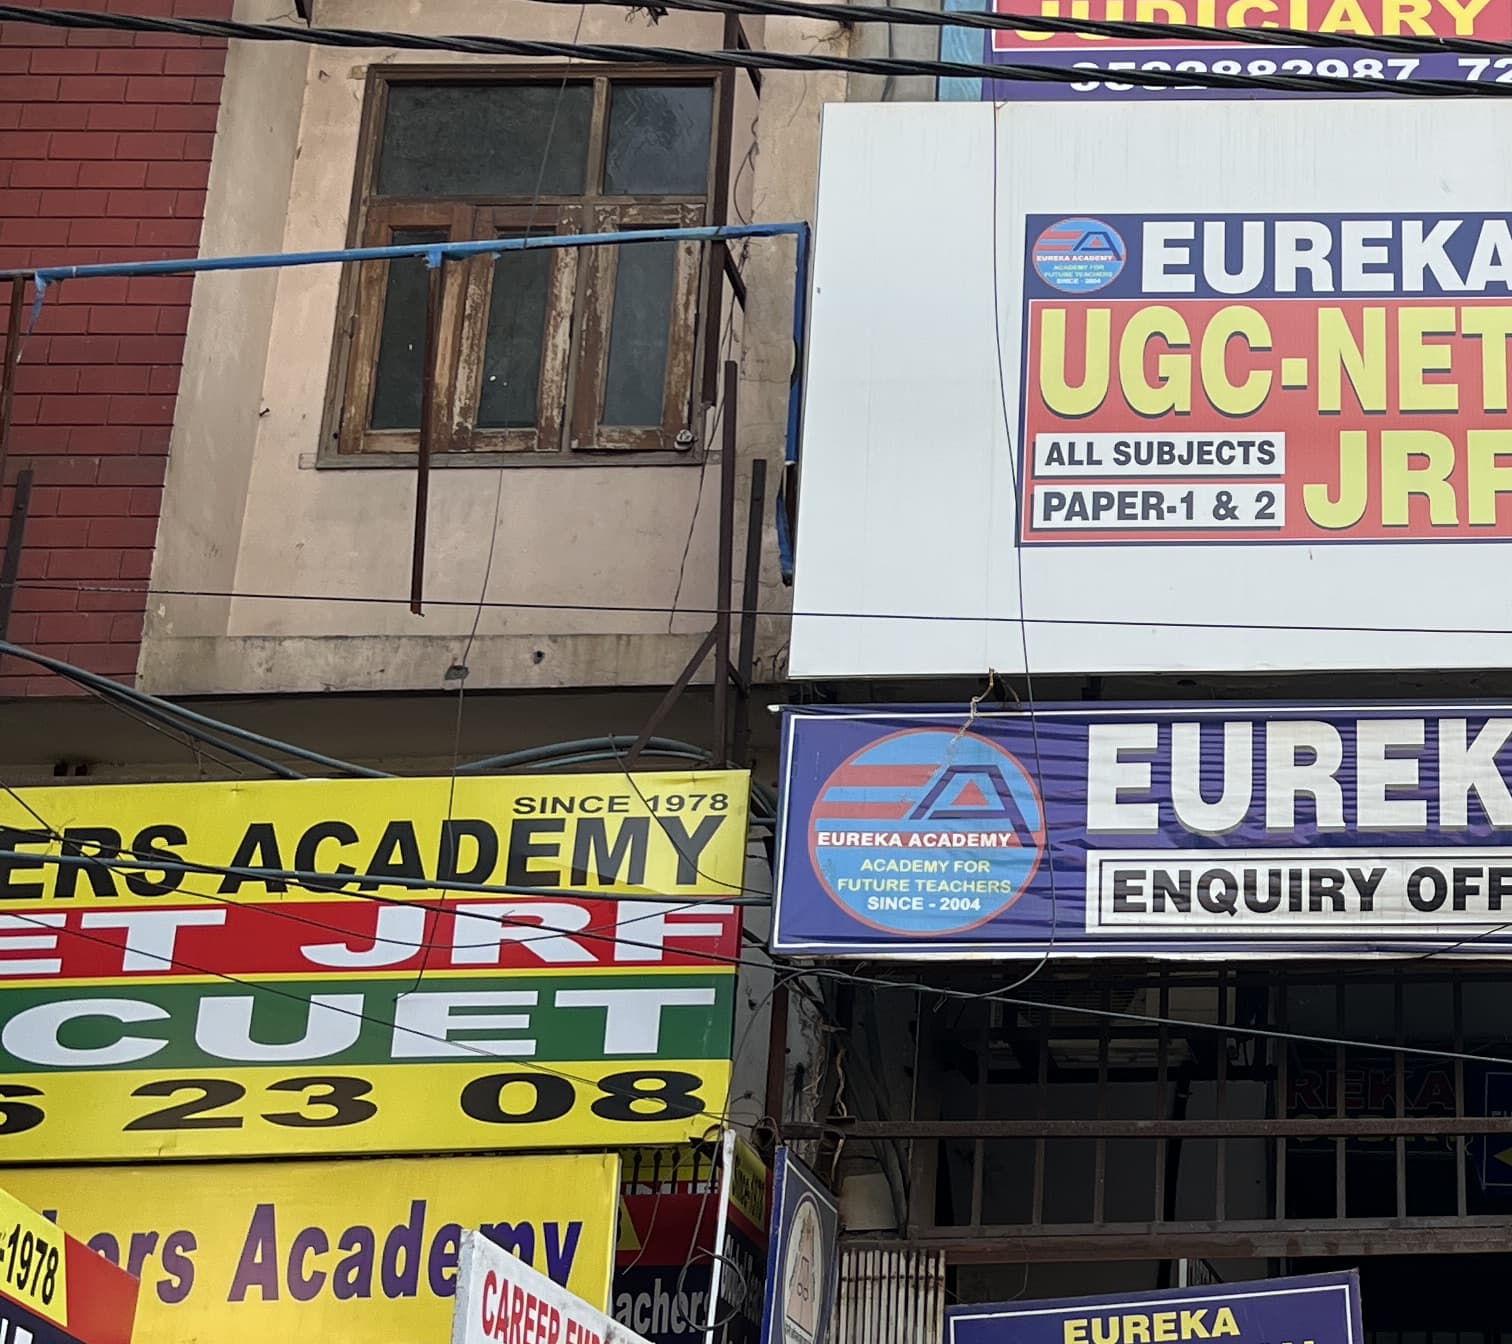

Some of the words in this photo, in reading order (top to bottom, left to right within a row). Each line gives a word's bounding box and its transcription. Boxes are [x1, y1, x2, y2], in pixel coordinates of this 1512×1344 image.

[1045, 441, 1106, 466] ALL
[1112, 438, 1275, 467] SUBJECTS
[1043, 490, 1196, 523] PAPER-1
[1212, 492, 1237, 522] &
[1255, 492, 1276, 520] 2
[513, 796, 631, 815] SINCE
[646, 793, 730, 813] 1978
[818, 832, 904, 847] EUREKA
[909, 832, 1013, 848] ACADEMY
[218, 815, 726, 897] ACADEMY
[861, 859, 948, 874] ACADEMY
[954, 860, 992, 872] FOR
[837, 879, 909, 893] FUTURE
[915, 879, 1011, 894] TEACHERS
[1112, 867, 1389, 917] ENQUIRY
[867, 897, 923, 911] SINCE
[940, 897, 981, 912] 2004
[300, 901, 733, 968] JRF
[2, 987, 716, 1066] CUET
[123, 1076, 377, 1131] 23
[461, 1071, 705, 1124] 08
